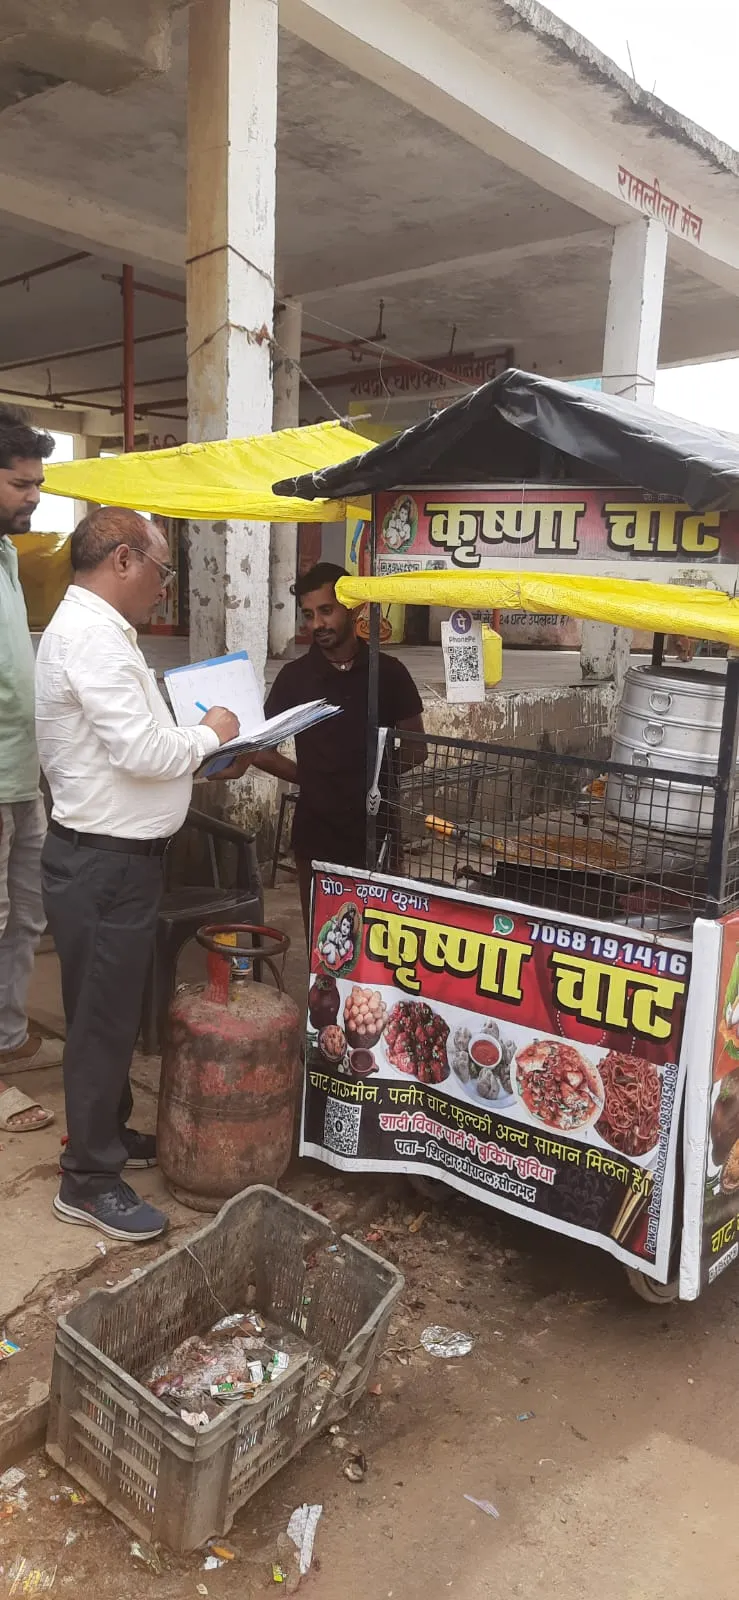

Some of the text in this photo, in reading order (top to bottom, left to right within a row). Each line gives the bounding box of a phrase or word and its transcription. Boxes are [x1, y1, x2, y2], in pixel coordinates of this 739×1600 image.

[617, 164, 703, 244] रामलीला मंच
[424, 502, 721, 567] कृष्णा चाट
[355, 883, 389, 904] कृष्ण
[391, 889, 430, 912] कुमार
[363, 908, 685, 1041] कृष्णा चाट
[527, 921, 688, 976] 7068191416
[379, 1111, 409, 1131] शादी
[411, 1113, 443, 1140] विवाह
[466, 1134, 476, 1154] में
[478, 1142, 513, 1169] बुकिंग
[515, 1156, 555, 1184] सुविधा
[388, 1085, 425, 1106] पनीर
[495, 1124, 529, 1150] अन्य
[533, 1133, 582, 1166] सामान
[585, 1148, 630, 1185] मिलता
[645, 1217, 659, 1254] Pawan
[660, 1063, 678, 1128] 9838454096
